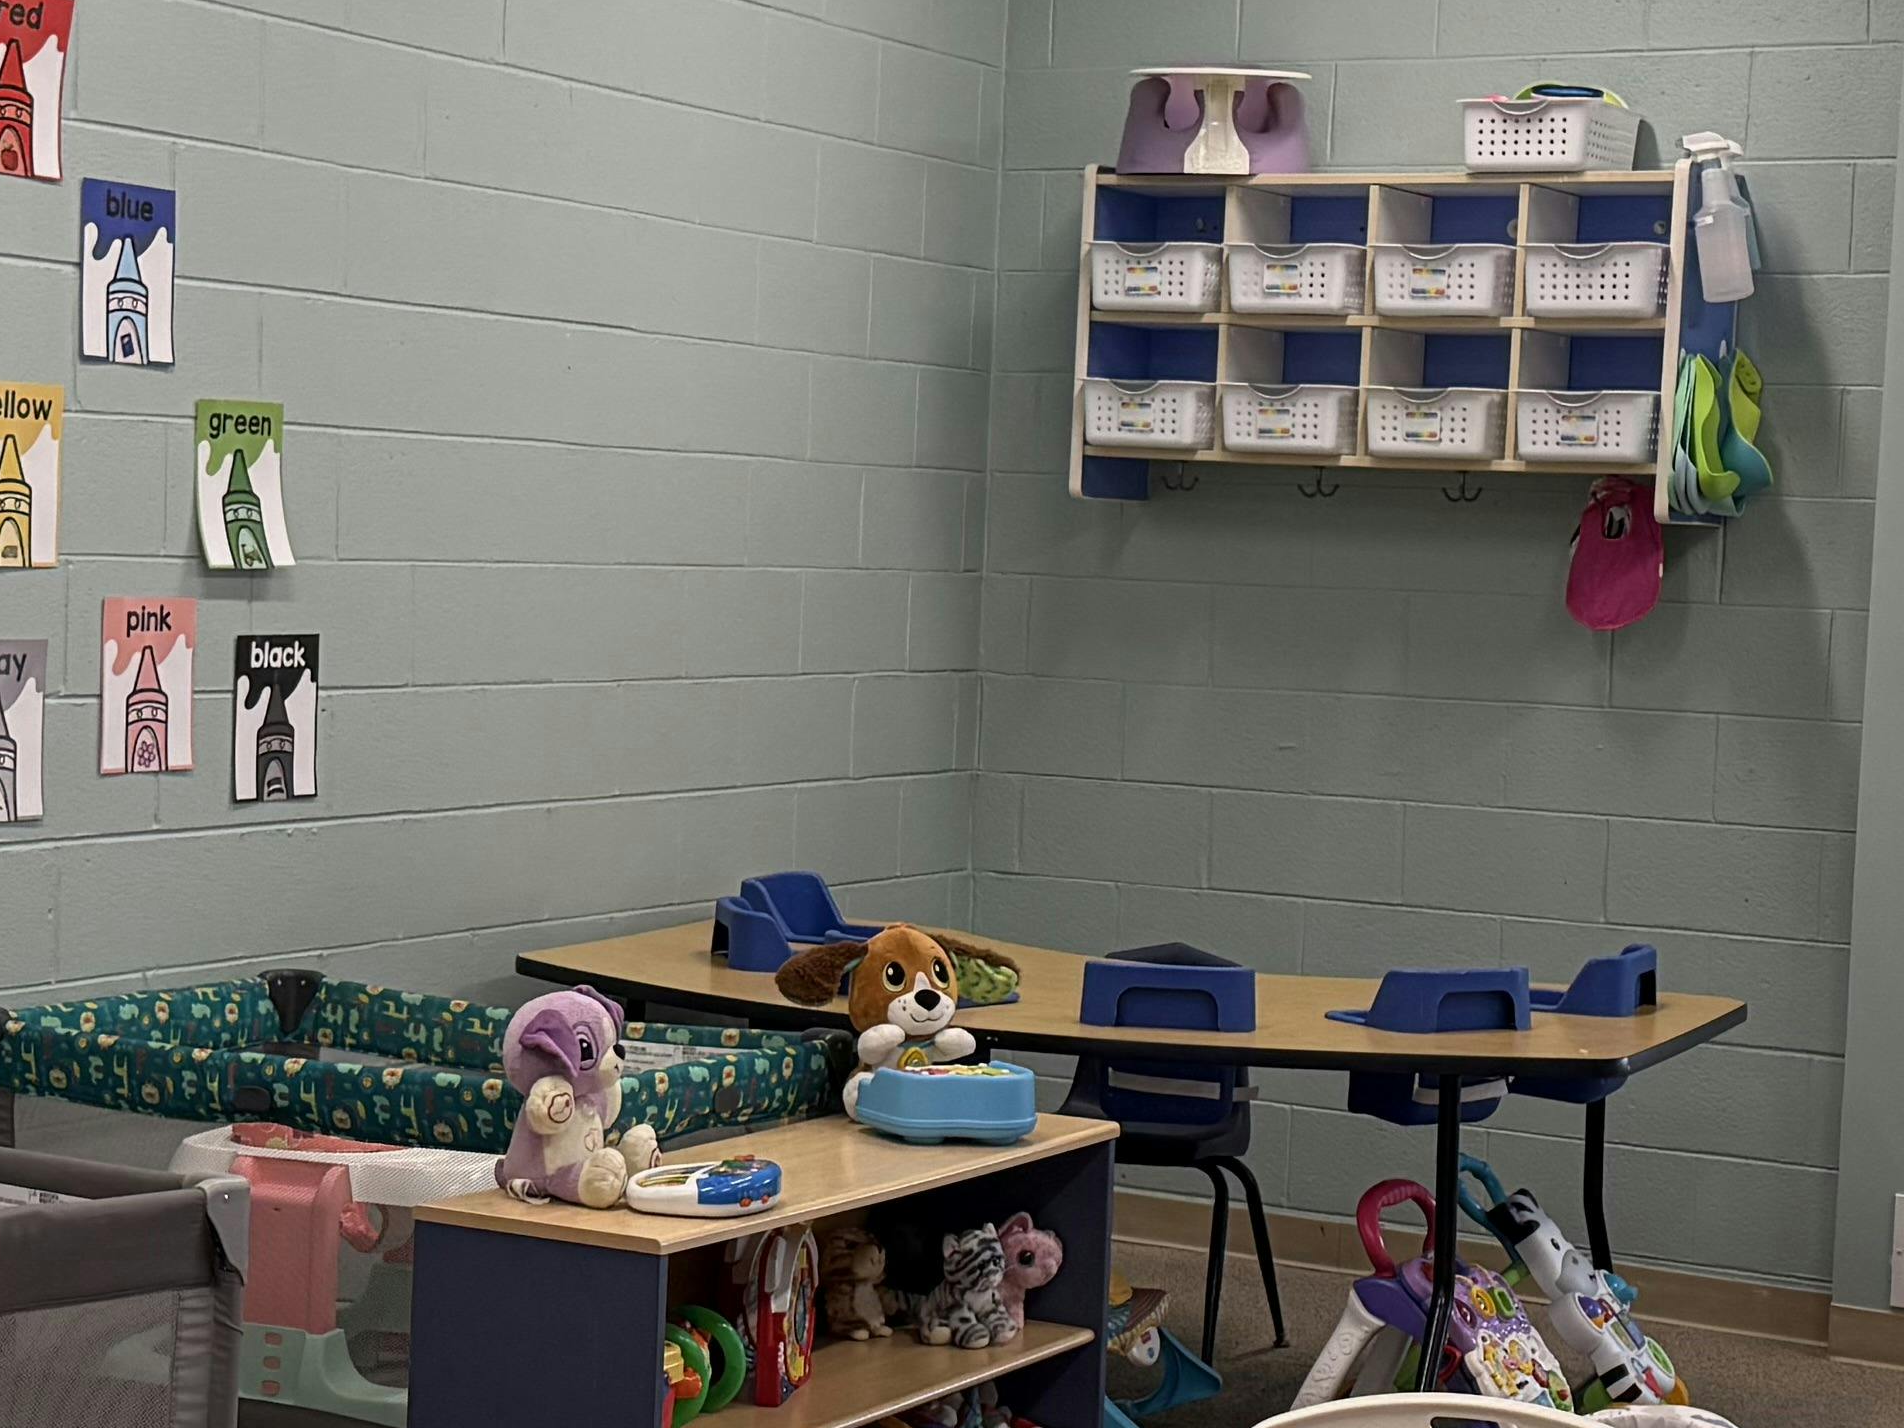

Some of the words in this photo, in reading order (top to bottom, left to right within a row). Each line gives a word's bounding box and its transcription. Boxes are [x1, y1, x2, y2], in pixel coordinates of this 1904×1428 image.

[105, 190, 154, 223] blue
[208, 410, 272, 440] green
[125, 604, 171, 634] pink
[250, 640, 306, 670] black
